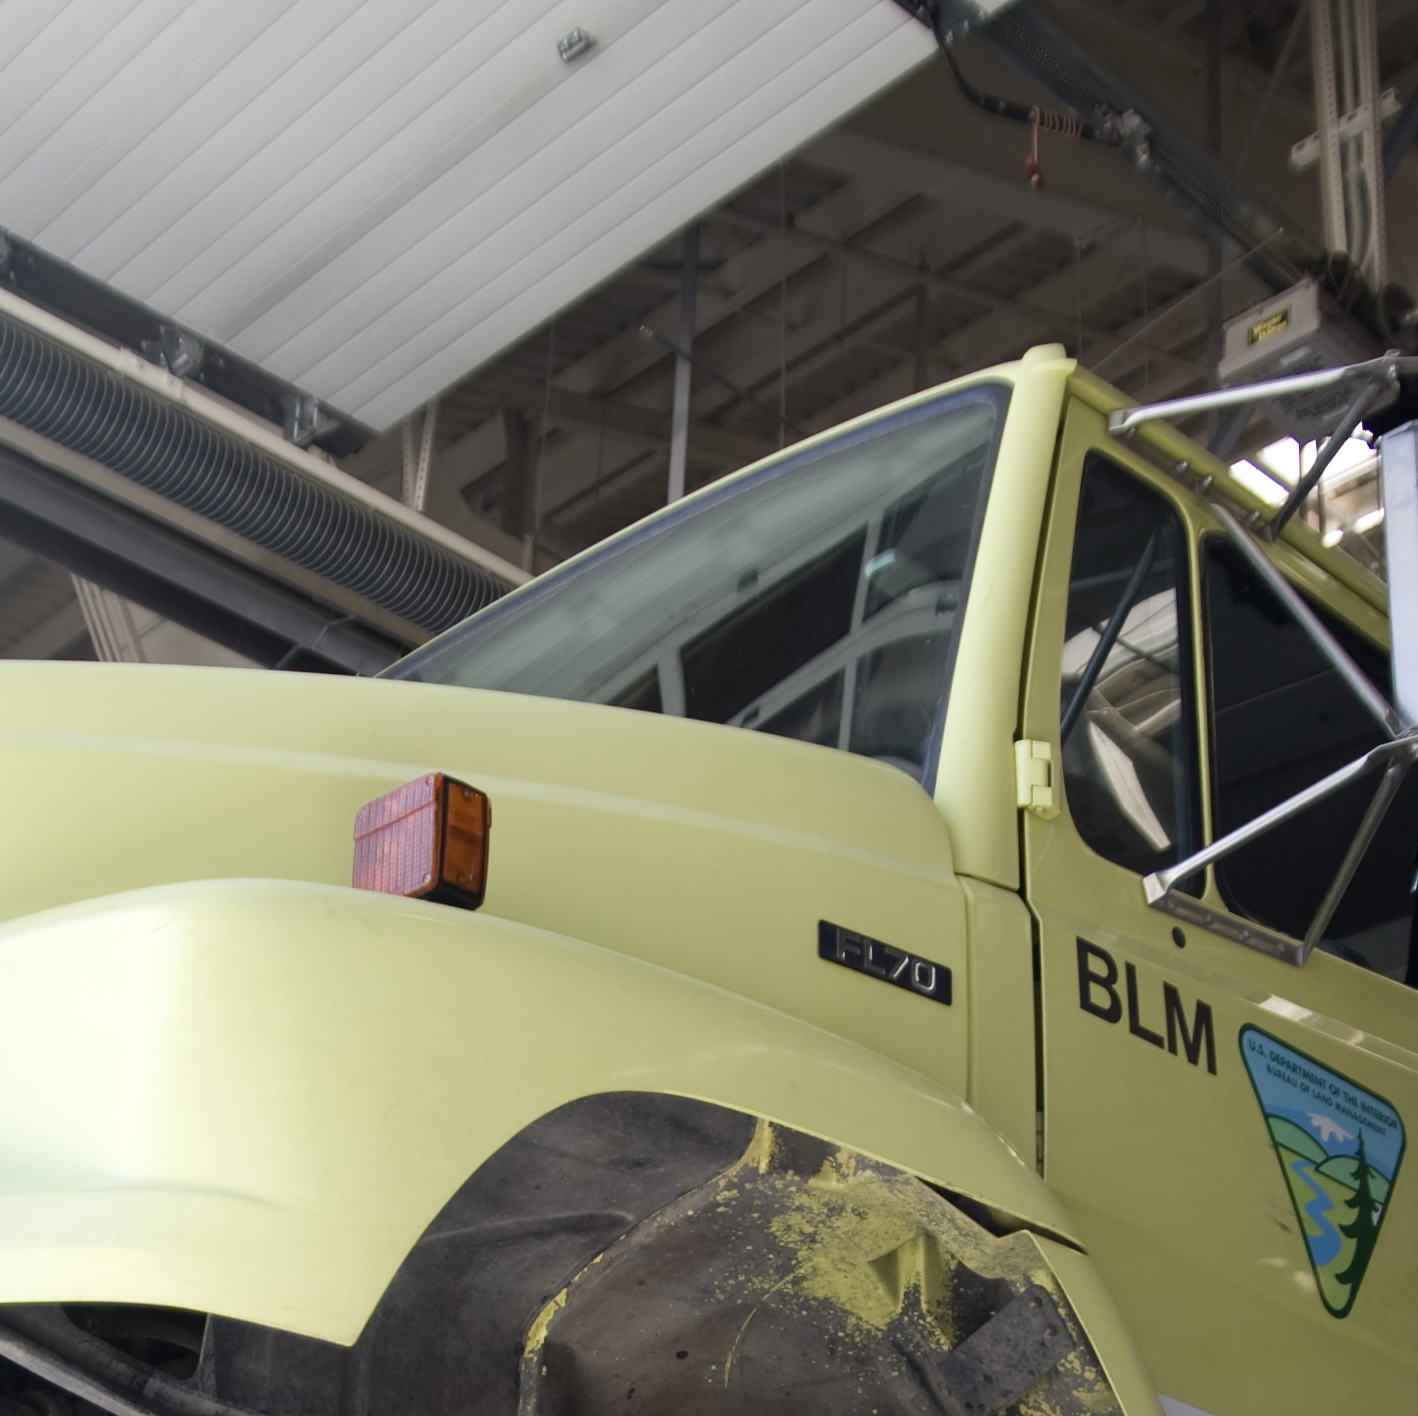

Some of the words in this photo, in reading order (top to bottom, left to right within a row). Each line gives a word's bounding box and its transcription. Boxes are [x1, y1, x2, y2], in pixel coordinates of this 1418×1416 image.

[836, 925, 937, 994] FL70
[1075, 935, 1217, 1075] BLM
[1248, 1038, 1268, 1058] U.S.
[1269, 1051, 1327, 1089] DEPARTMENT
[1329, 1083, 1341, 1097] OF
[1342, 1090, 1359, 1107] THE
[1360, 1100, 1399, 1129] INTERIOR
[1266, 1063, 1298, 1088] BUREAU
[1300, 1081, 1310, 1094] OF
[1312, 1088, 1333, 1107] LAND
[1335, 1101, 1387, 1135] MANAGEMENT
